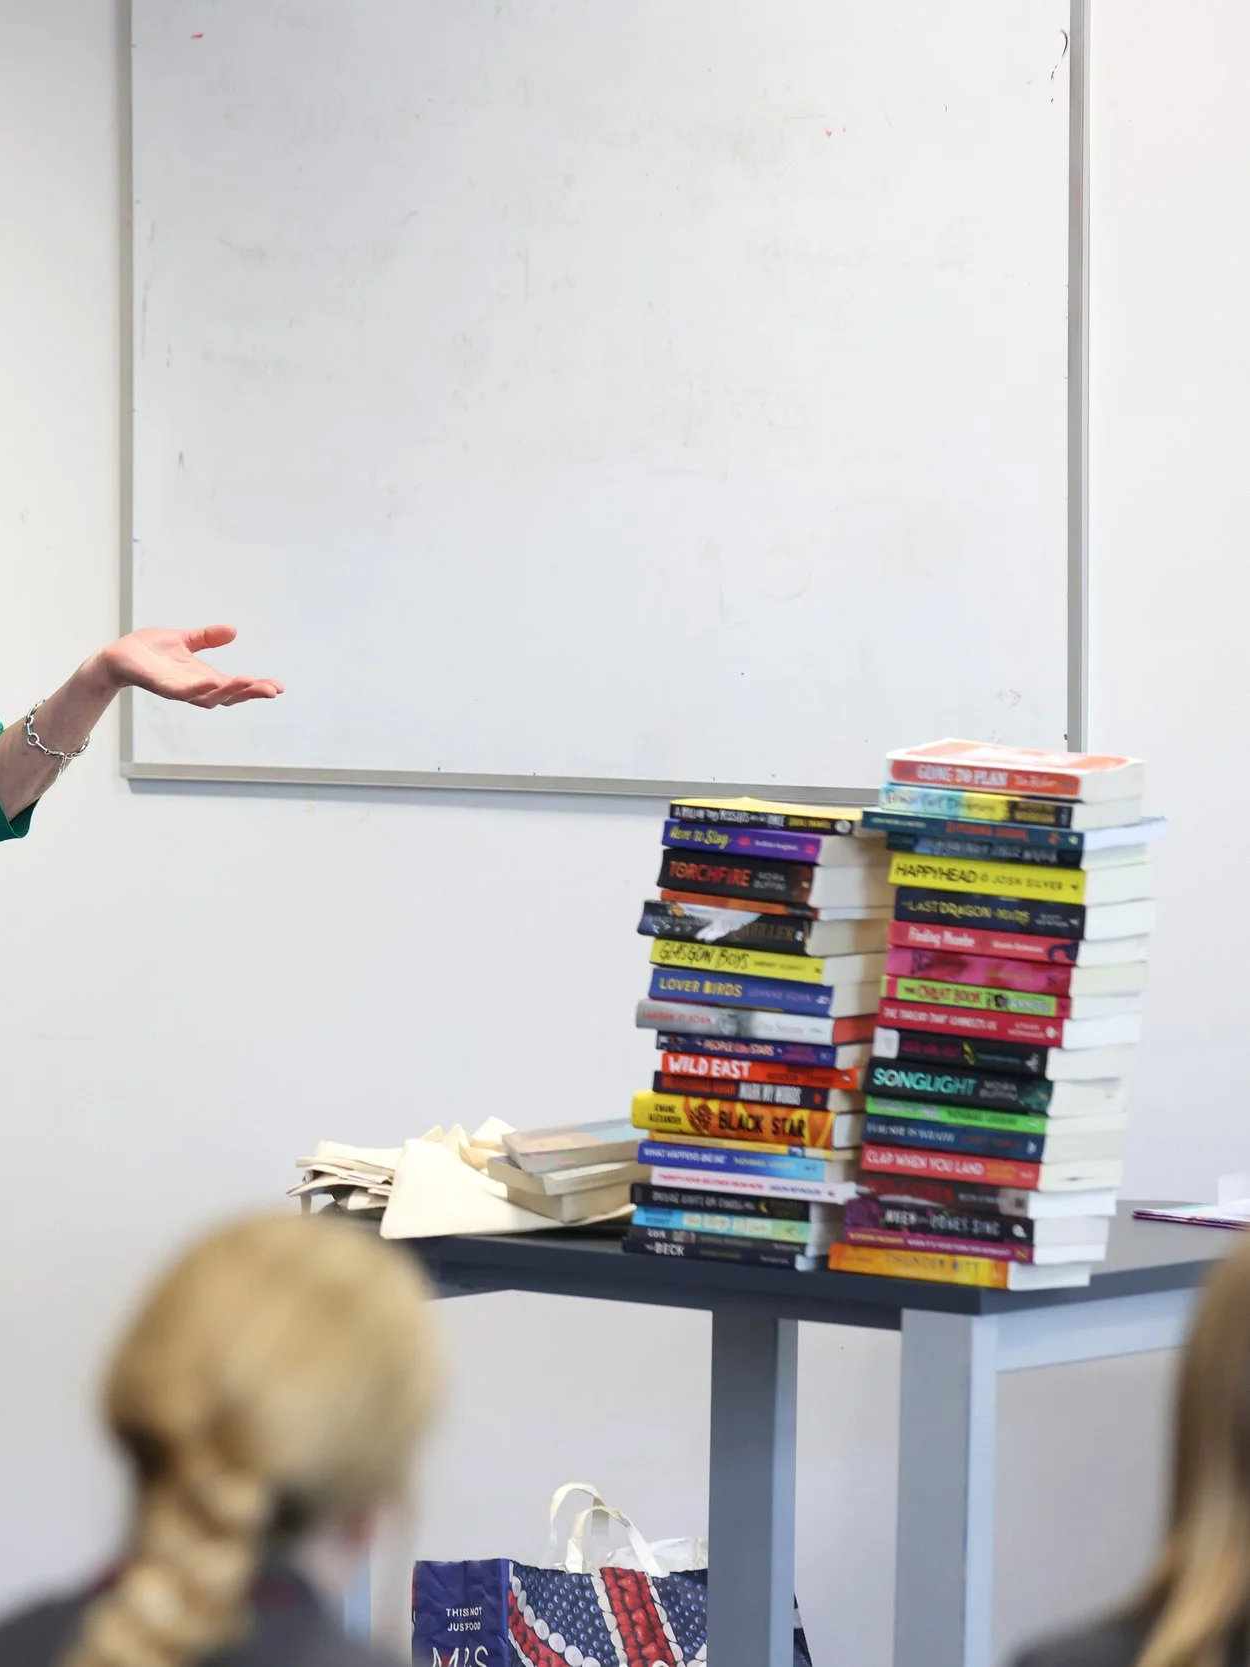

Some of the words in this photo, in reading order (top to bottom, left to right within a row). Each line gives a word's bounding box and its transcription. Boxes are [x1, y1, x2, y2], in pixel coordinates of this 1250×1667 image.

[917, 765, 953, 781] GOING
[955, 768, 973, 783] TO
[973, 769, 1010, 787] PLAN
[694, 831, 705, 842] to
[704, 829, 731, 849] Stay
[669, 860, 751, 887] TORCHFIRE
[896, 864, 978, 884] HAPPYHEAD
[992, 875, 1022, 886] JOSH
[1026, 878, 1064, 891] SILVER
[908, 901, 940, 915] LAST
[939, 902, 992, 919] DRAGON
[908, 926, 941, 946] Finding
[659, 942, 713, 964] GLASGOW
[715, 948, 750, 970] BOYS
[659, 977, 700, 993] LOVER
[702, 981, 743, 997] BIRDS
[883, 1007, 897, 1019] THE
[929, 1013, 948, 1025] THAT
[750, 1044, 775, 1056] STARS
[667, 1055, 710, 1076] WILD
[712, 1059, 753, 1079] EAST
[873, 1067, 978, 1096] SONGLIGHT
[775, 1085, 803, 1106] WORDS
[719, 1111, 764, 1134] BLACK
[772, 1117, 807, 1138] STAR
[644, 1147, 666, 1158] WHAT
[866, 1150, 893, 1165] CLAP
[894, 1153, 927, 1169] WHEN
[928, 1157, 953, 1172] YOU
[954, 1161, 984, 1176] LAND
[972, 1218, 1000, 1236] SING
[654, 1241, 685, 1257] BECK
[469, 1606, 482, 1616] NOT
